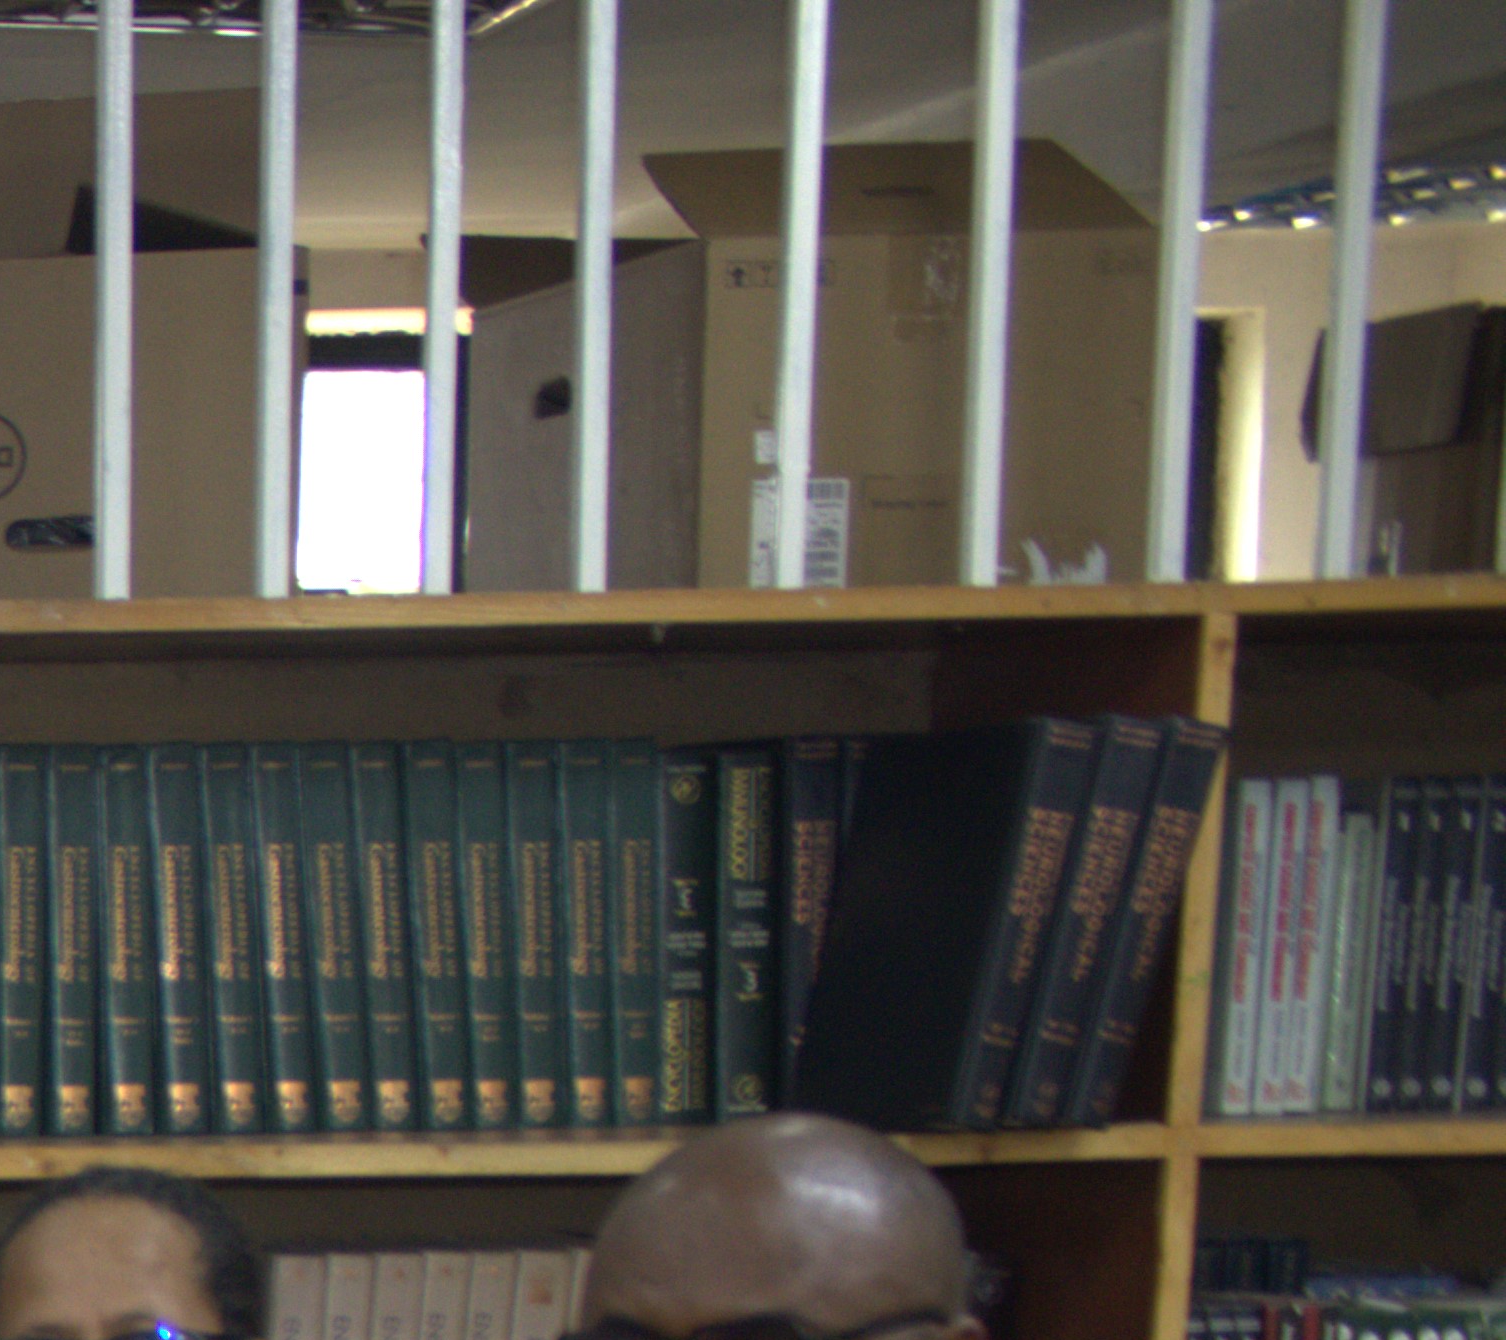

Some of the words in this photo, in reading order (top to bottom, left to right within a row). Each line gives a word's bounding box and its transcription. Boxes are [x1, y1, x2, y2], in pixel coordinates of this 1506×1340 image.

[730, 768, 750, 881] IMMUNOLOGY
[791, 819, 814, 925] SCIENCES
[1008, 805, 1055, 917] SCIENCES
[1070, 804, 1116, 916] SCIENCES
[1009, 810, 1075, 984] NEUROLOGICAL
[1072, 810, 1140, 983] NEUROLOGICAL
